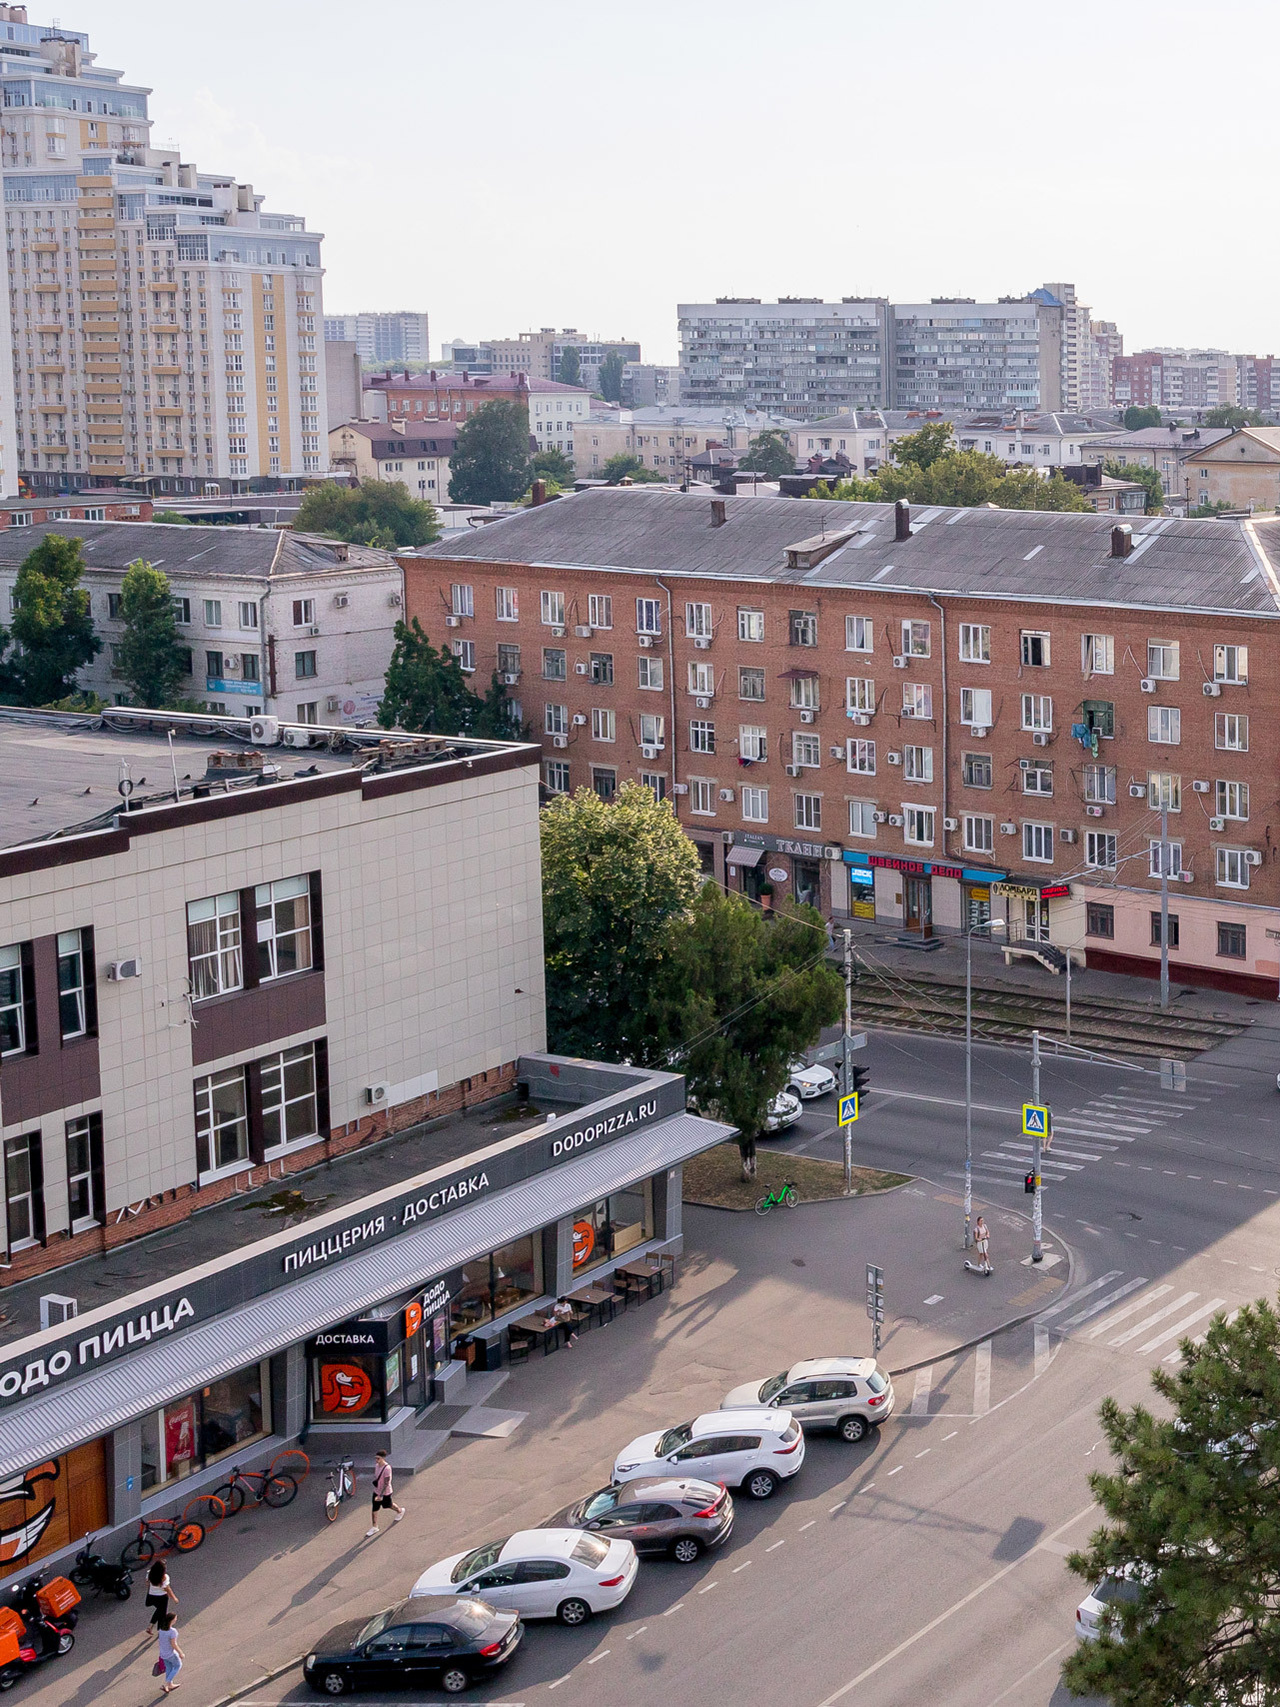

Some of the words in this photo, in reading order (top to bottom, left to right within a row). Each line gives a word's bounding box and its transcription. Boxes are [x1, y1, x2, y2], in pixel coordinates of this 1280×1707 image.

[930, 861, 962, 879] ДЕЛО
[1000, 884, 1037, 896] ЛОМБАРД
[552, 1100, 657, 1156] DODOPIZZA.RU
[284, 1215, 385, 1273] ПИЦЦЕРИЯ
[402, 1172, 490, 1226] ДОСТАВКА
[423, 1279, 446, 1307] ДОДО
[423, 1289, 451, 1320] ПИЦЦА
[79, 1297, 195, 1365] ПИЦЦА
[315, 1334, 375, 1346] ДОСТАВКА
